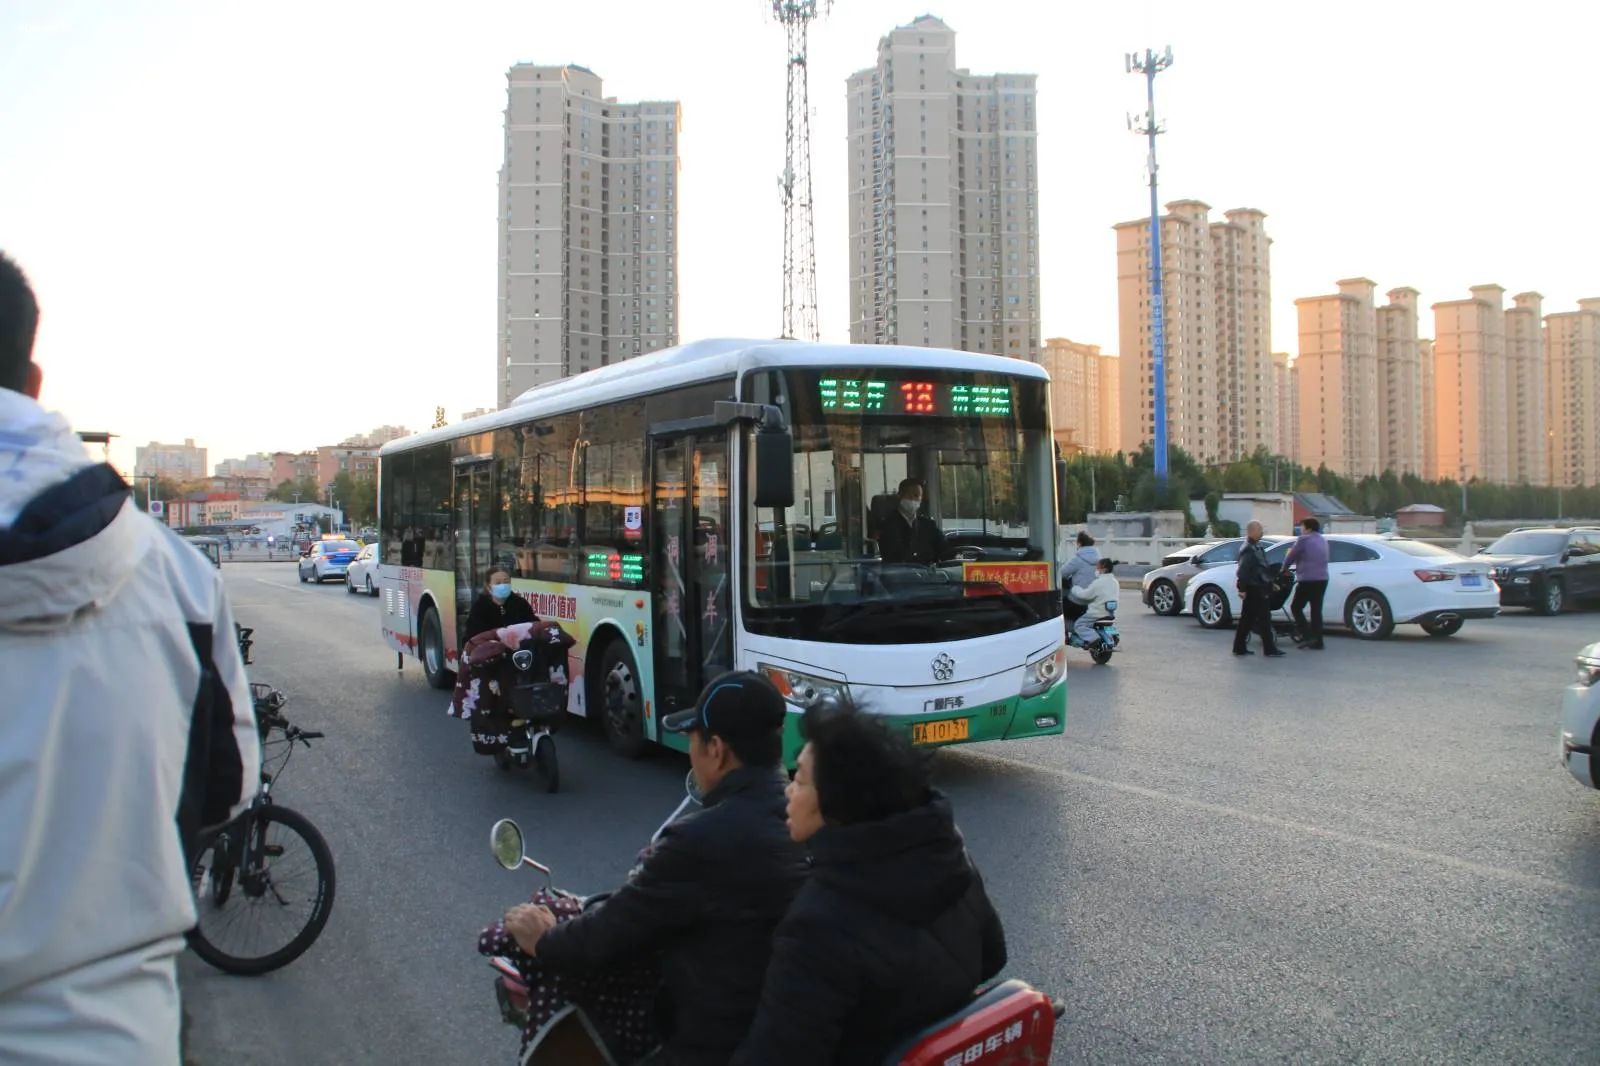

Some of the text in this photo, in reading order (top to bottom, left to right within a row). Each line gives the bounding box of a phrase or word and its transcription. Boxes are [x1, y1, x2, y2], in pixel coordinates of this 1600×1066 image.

[514, 591, 577, 621] 核心价值观
